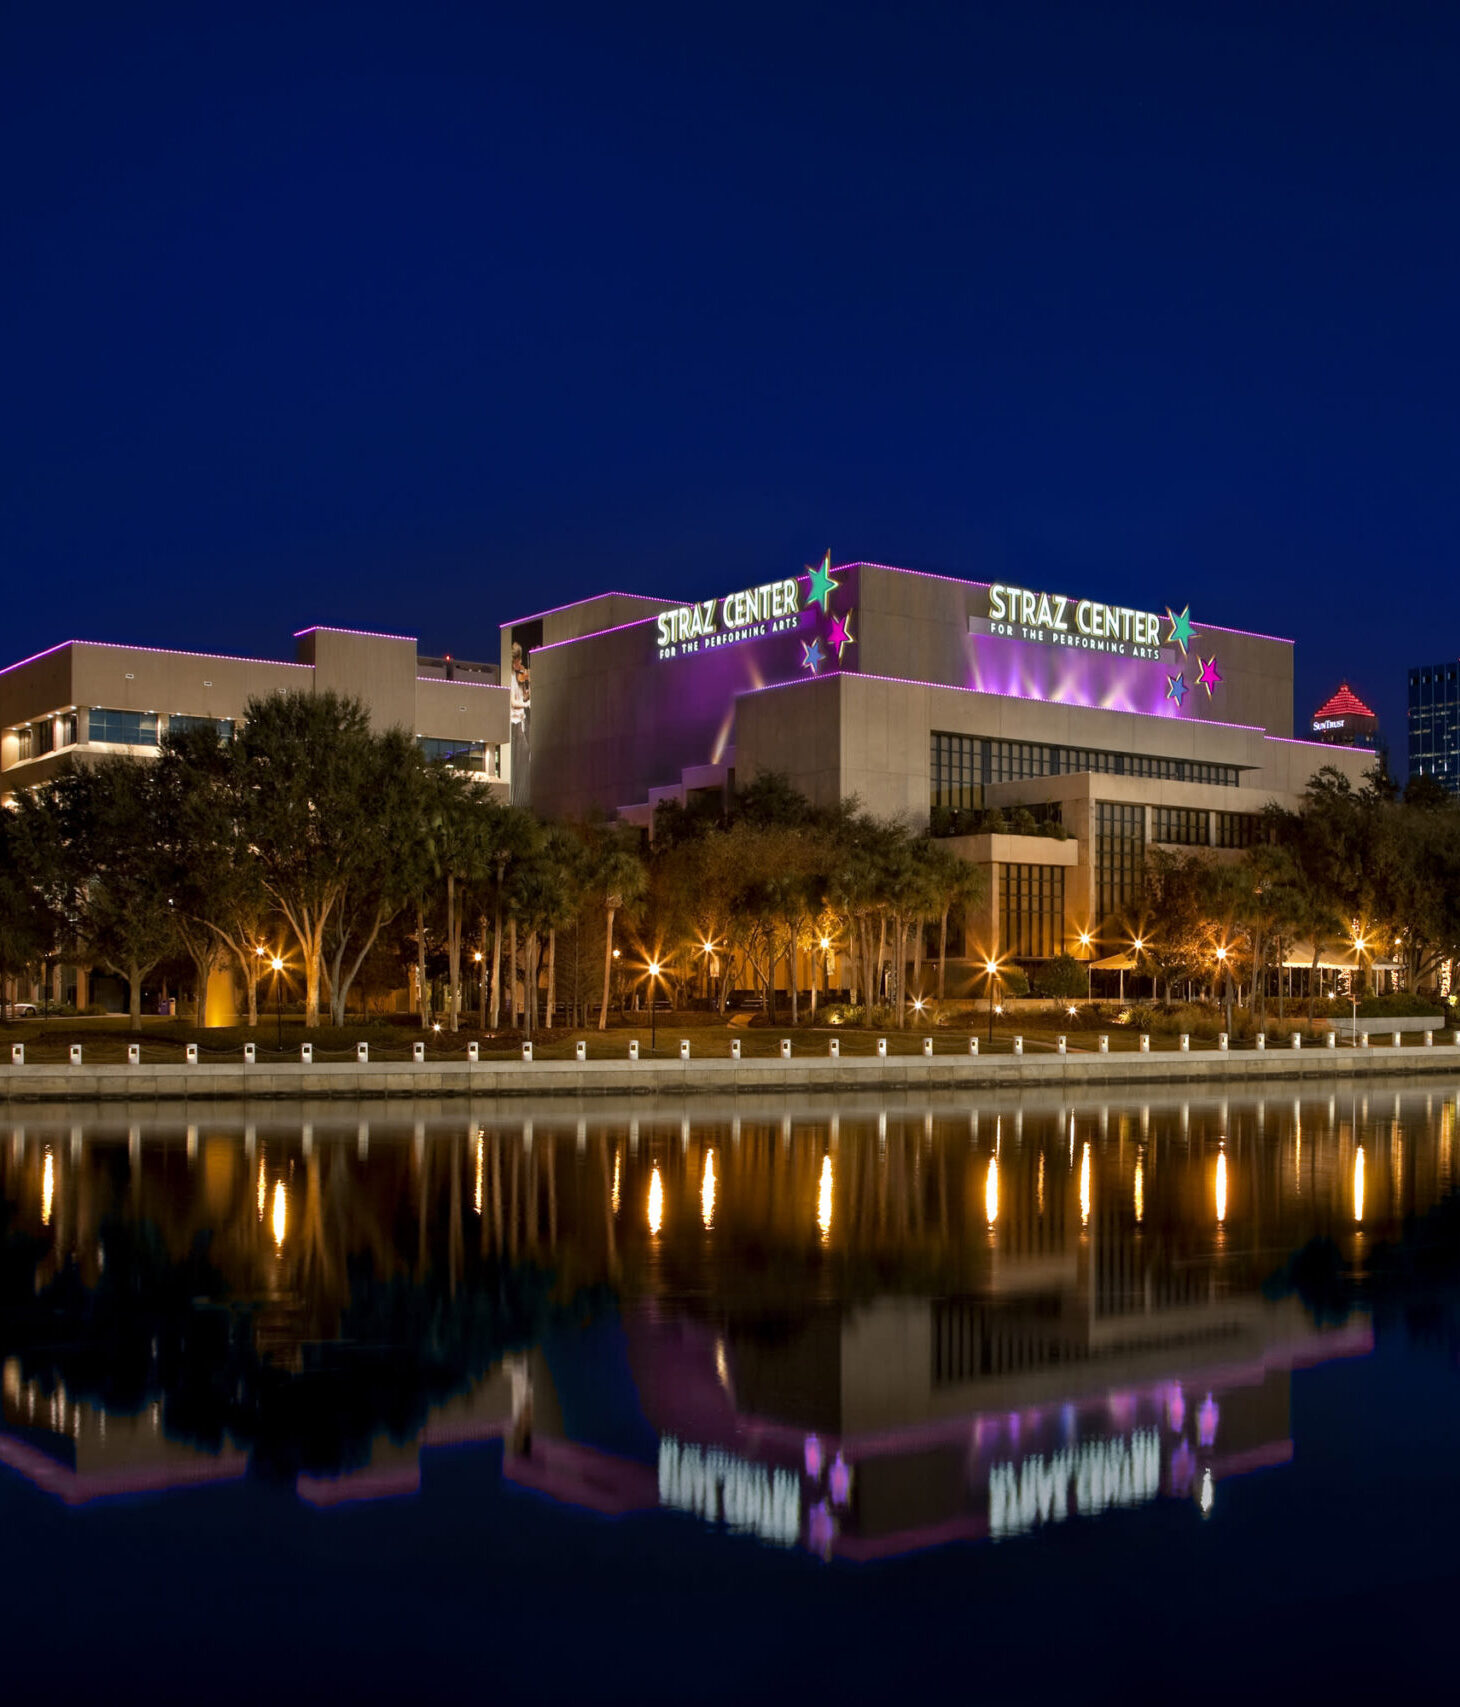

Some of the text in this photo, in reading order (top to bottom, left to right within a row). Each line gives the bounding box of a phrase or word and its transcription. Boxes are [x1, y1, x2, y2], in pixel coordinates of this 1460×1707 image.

[657, 577, 799, 646] STRAZ CENTER
[659, 616, 798, 660] FOR THE PERFORMING ARTS
[989, 583, 1160, 646] STRAZ CENTER
[990, 622, 1160, 660] FOR THE PERFORMING ARTS
